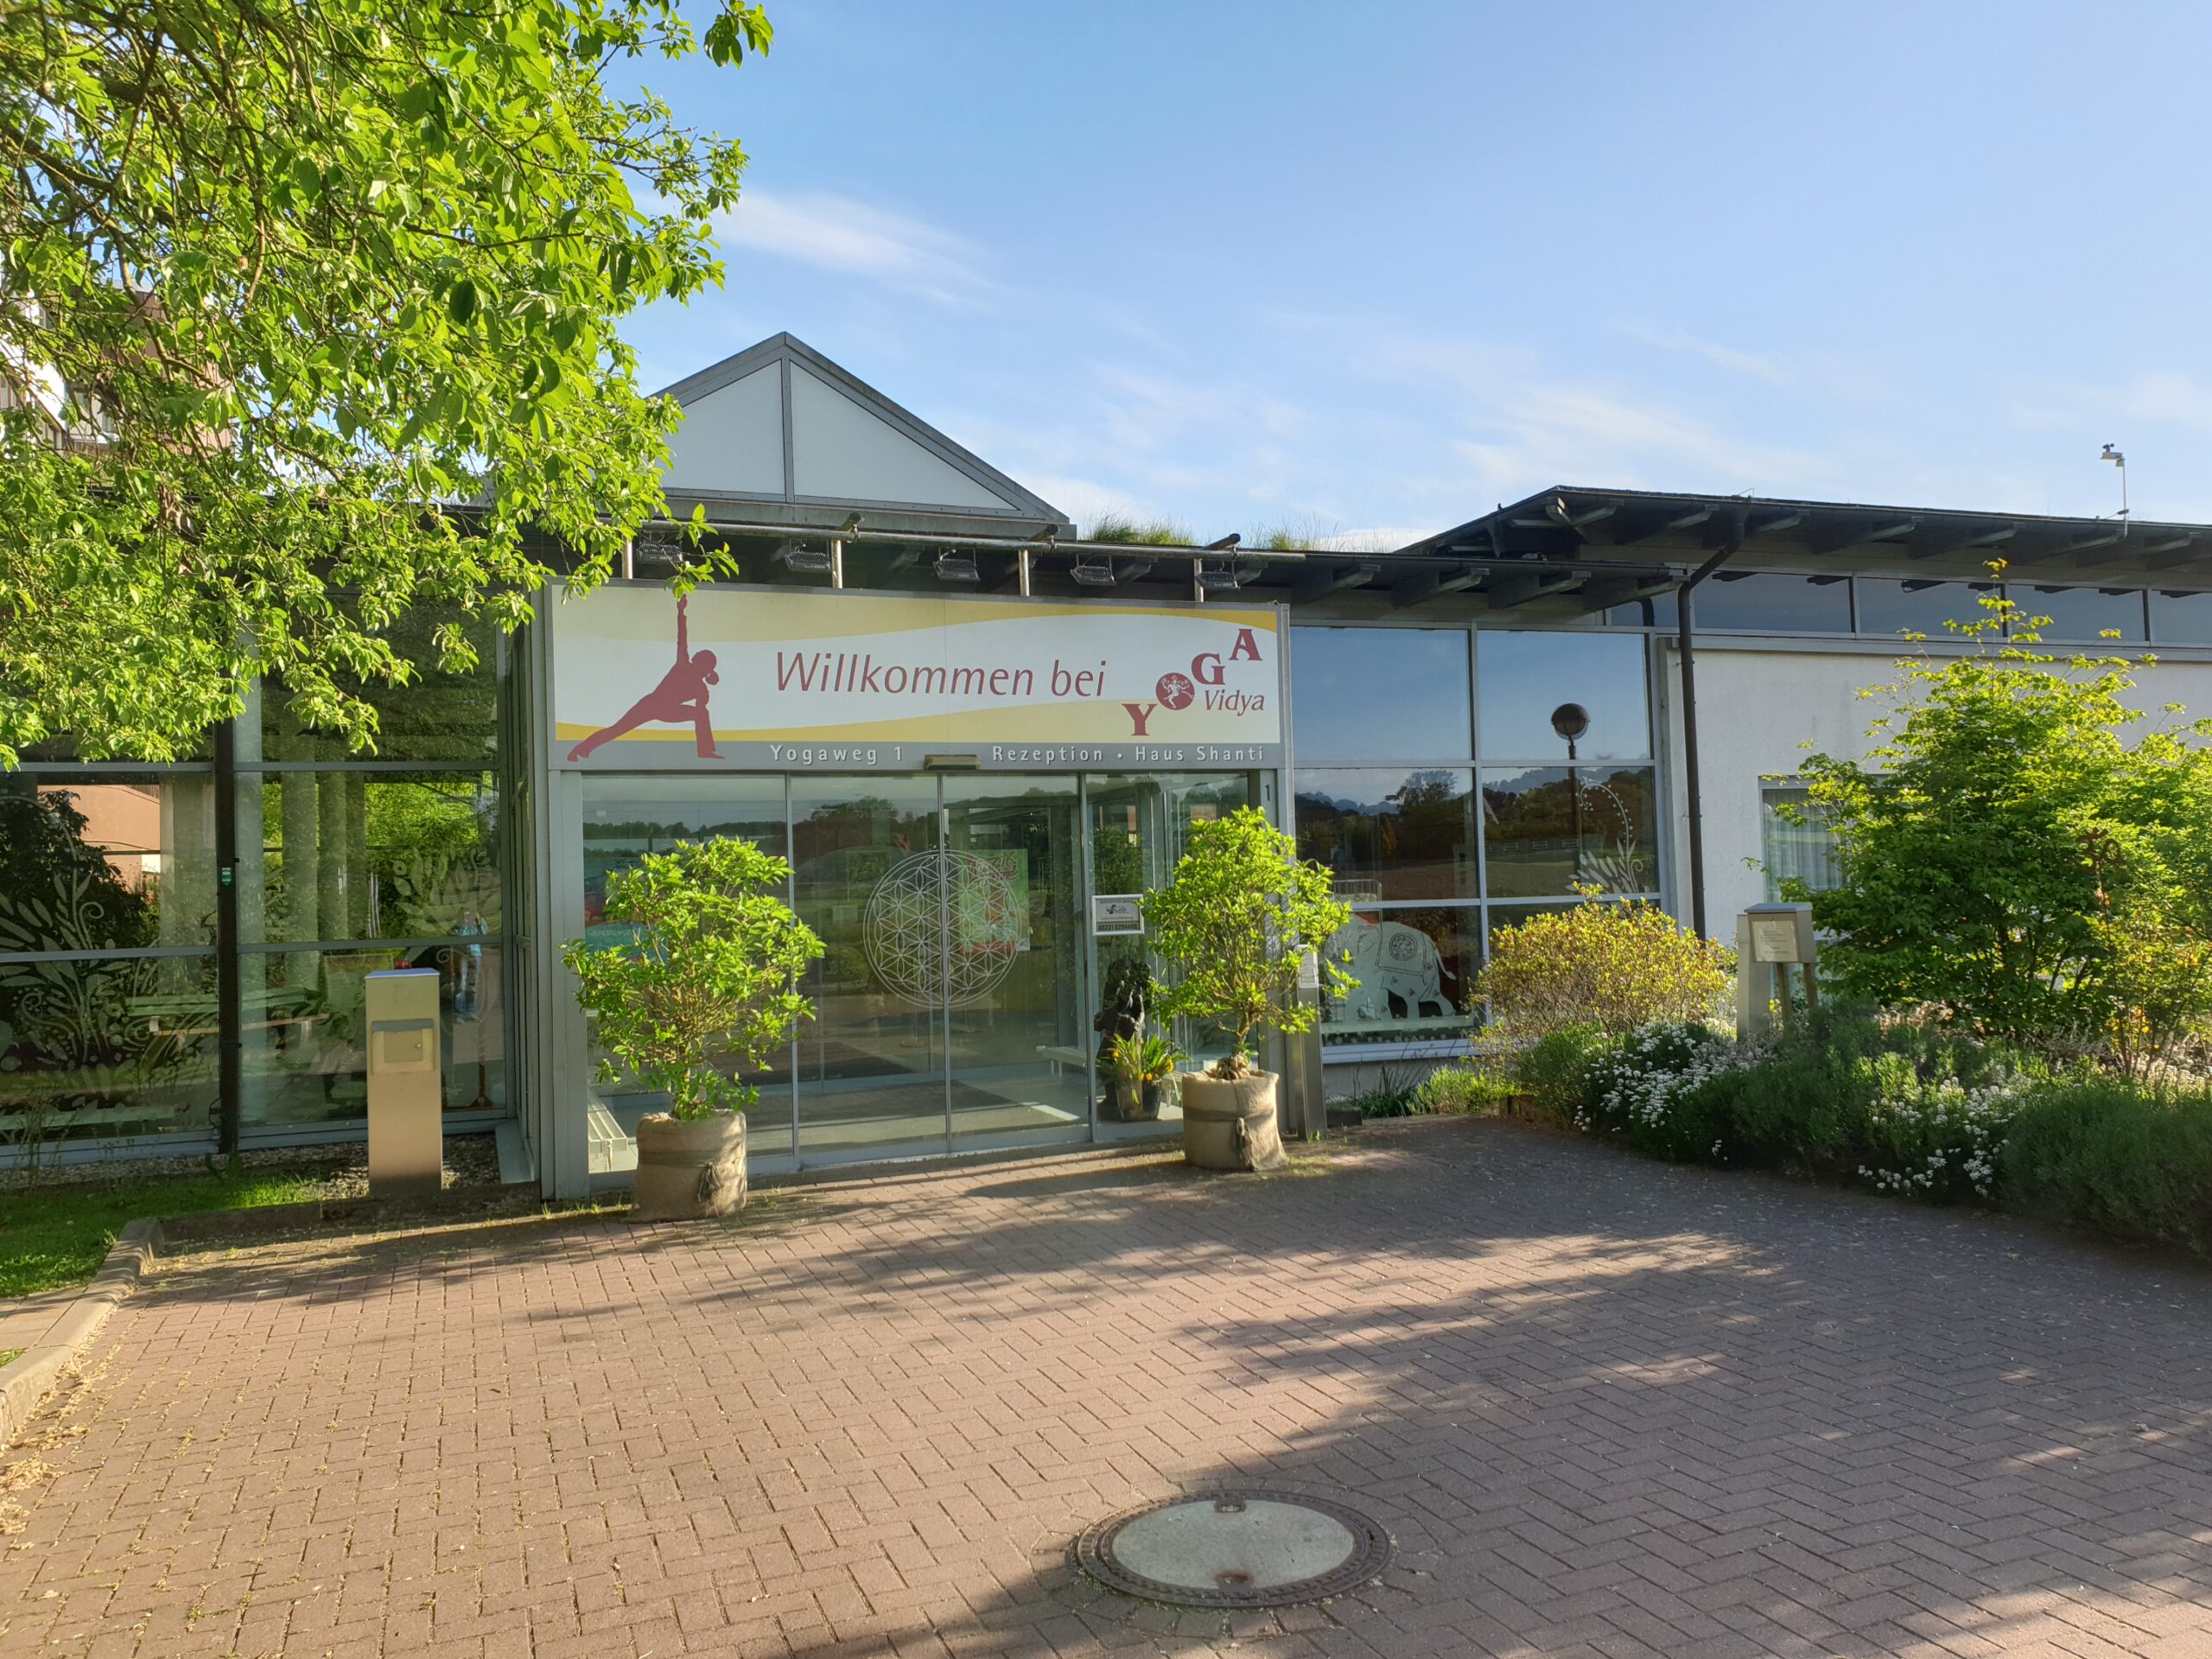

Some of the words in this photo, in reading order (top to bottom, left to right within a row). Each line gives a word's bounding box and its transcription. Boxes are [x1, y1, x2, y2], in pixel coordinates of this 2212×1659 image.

[777, 651, 1034, 696] Willkommen
[1051, 659, 1107, 696] bei
[1204, 690, 1266, 716] Vidya
[770, 744, 879, 765] Yogaweg
[893, 745, 903, 761] 1
[992, 746, 1104, 766] Rezeption
[1135, 746, 1185, 762] Haus
[1196, 747, 1265, 762] Shanti
[1264, 783, 1271, 802] 1
